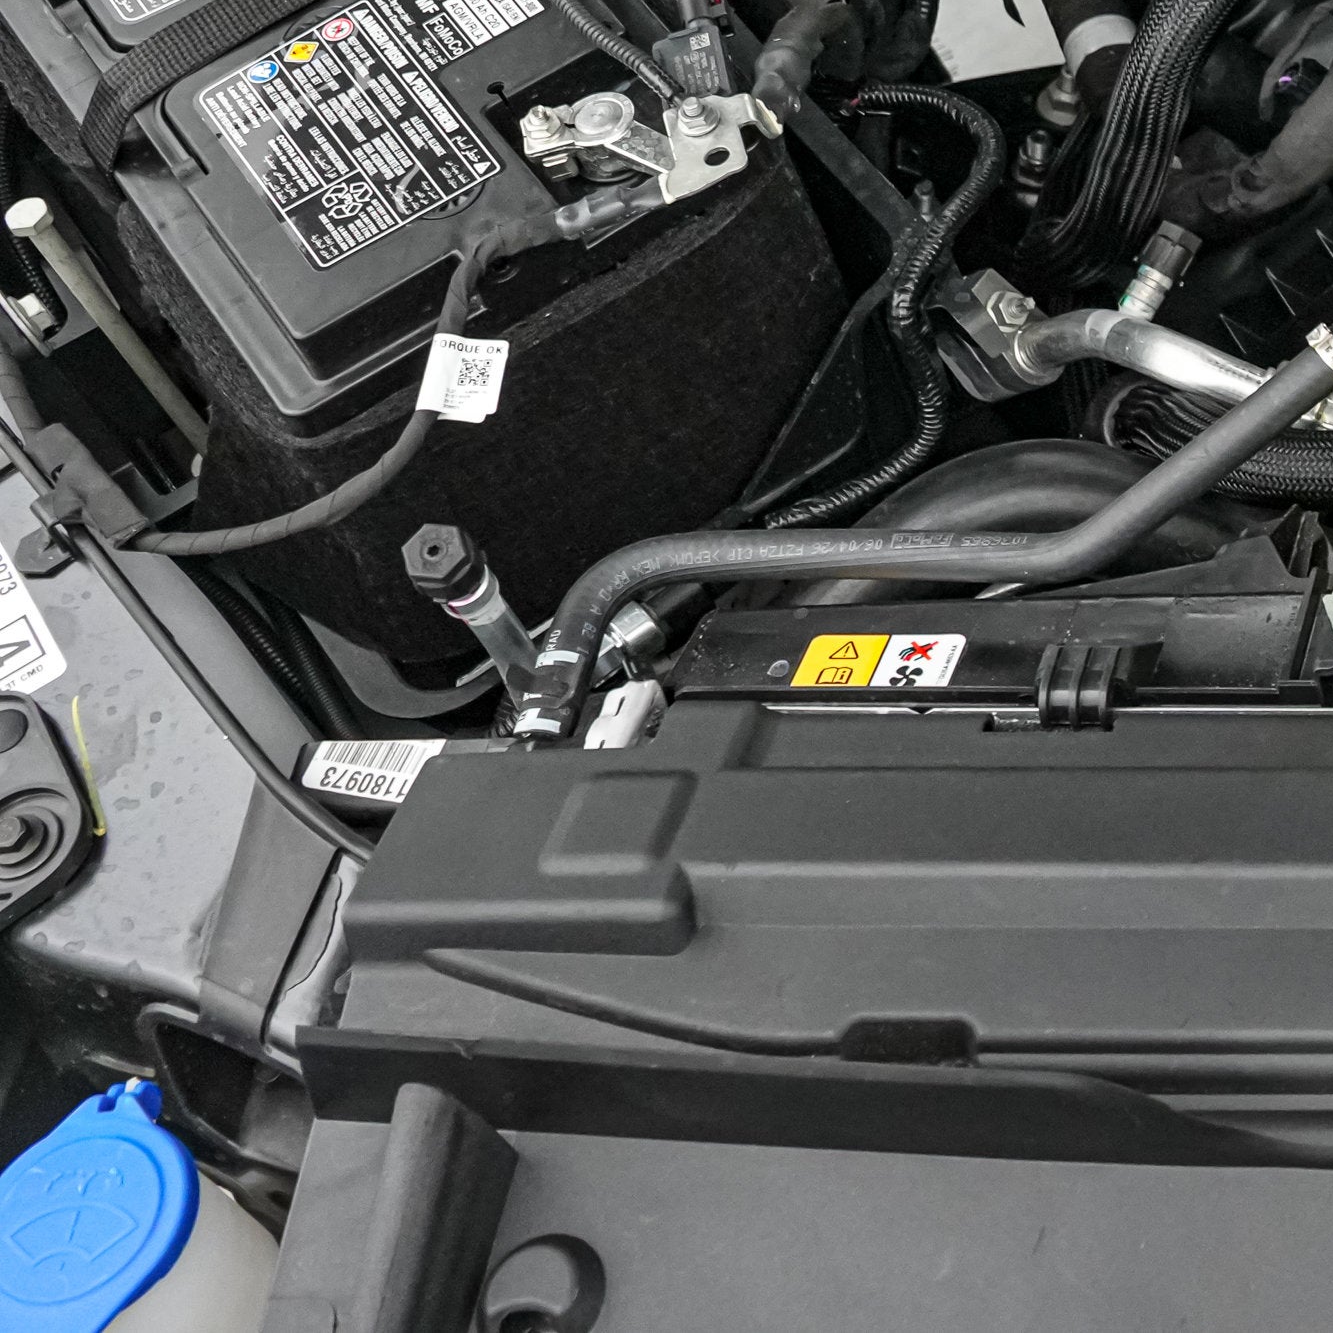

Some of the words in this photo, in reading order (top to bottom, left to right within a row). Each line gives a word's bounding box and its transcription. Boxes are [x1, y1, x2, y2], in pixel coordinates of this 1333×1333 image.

[448, 1, 485, 40] AGM/VRLA
[475, 3, 489, 14] Ah
[483, 13, 501, 29] C20
[428, 17, 467, 56] FoMoCo
[408, 76, 459, 133] PELIGRO/VENENO
[434, 339, 480, 354] ORQUE
[487, 346, 503, 355] OK
[545, 629, 561, 651] RAD
[319, 767, 409, 799] 1180973
